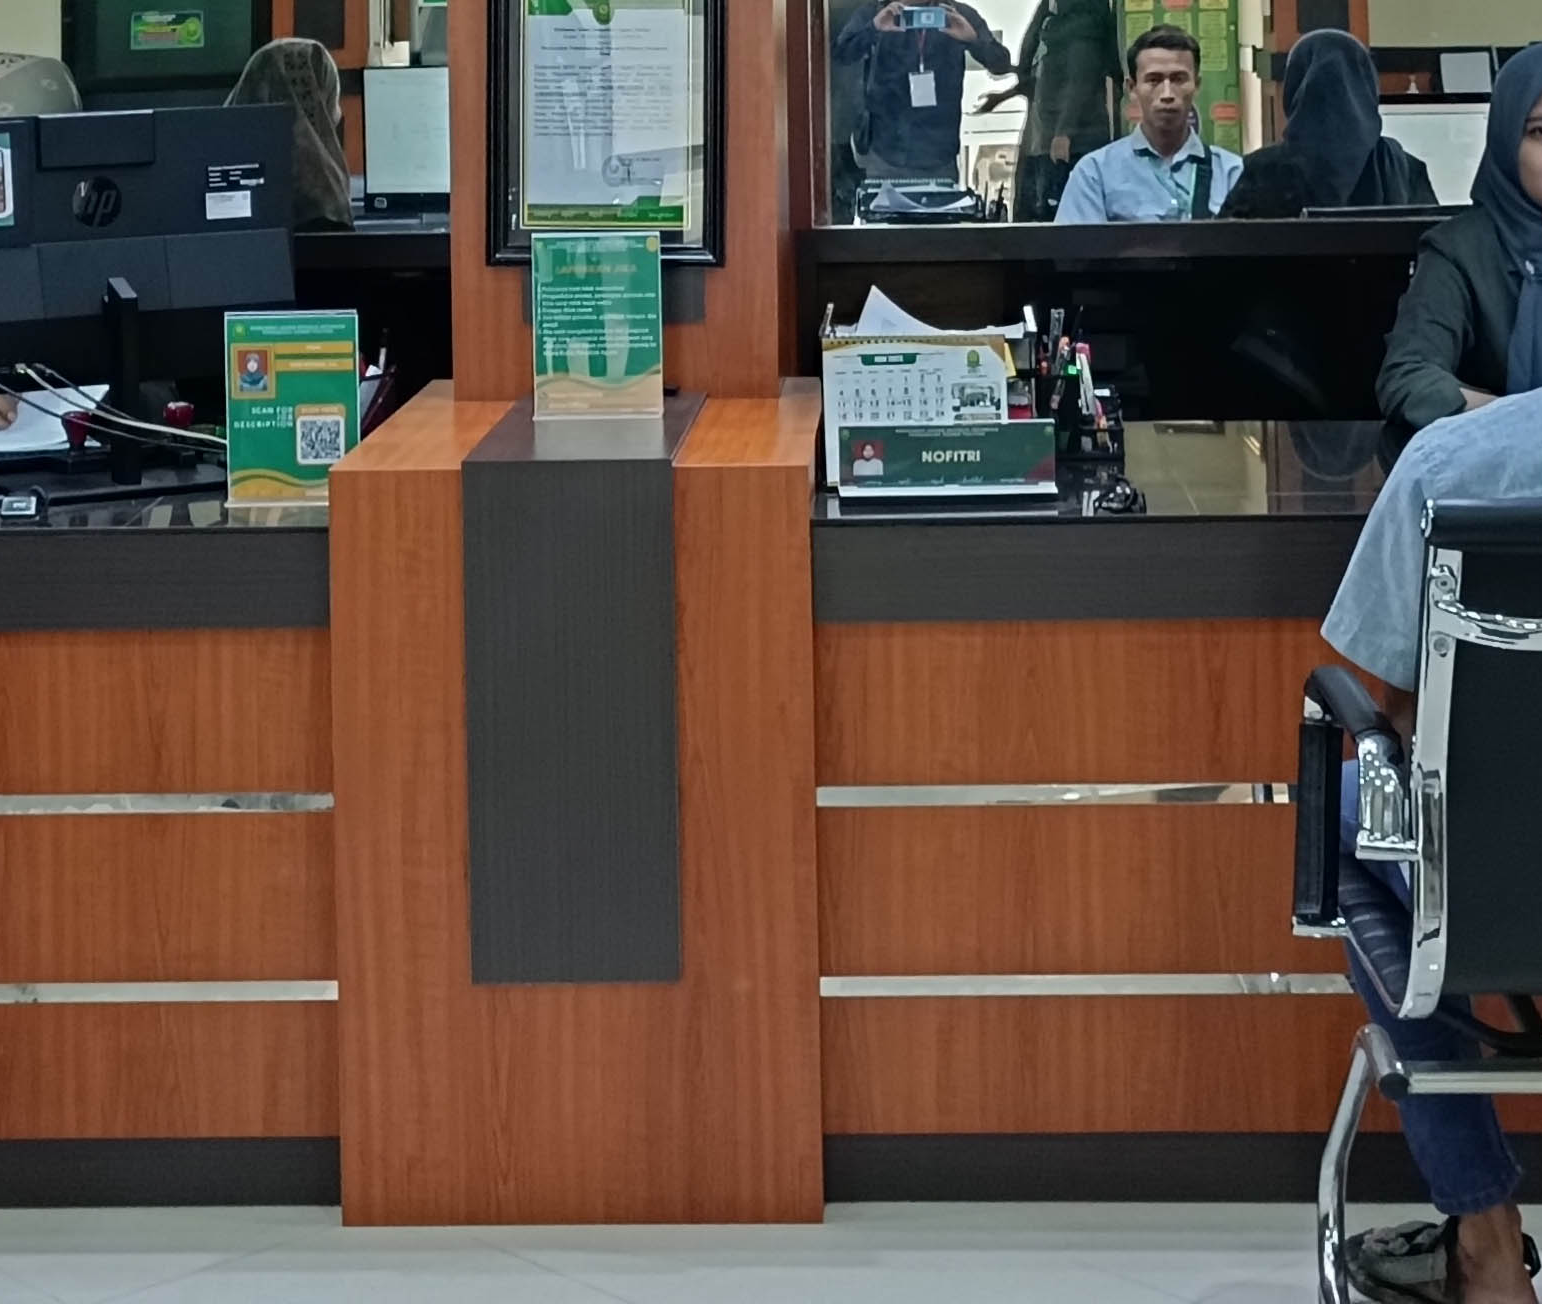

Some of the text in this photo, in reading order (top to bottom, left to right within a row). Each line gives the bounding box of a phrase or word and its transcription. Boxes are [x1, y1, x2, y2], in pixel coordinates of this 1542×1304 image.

[77, 178, 117, 227] hp
[251, 406, 274, 415] SCAN
[922, 450, 981, 463] NOFITRI
